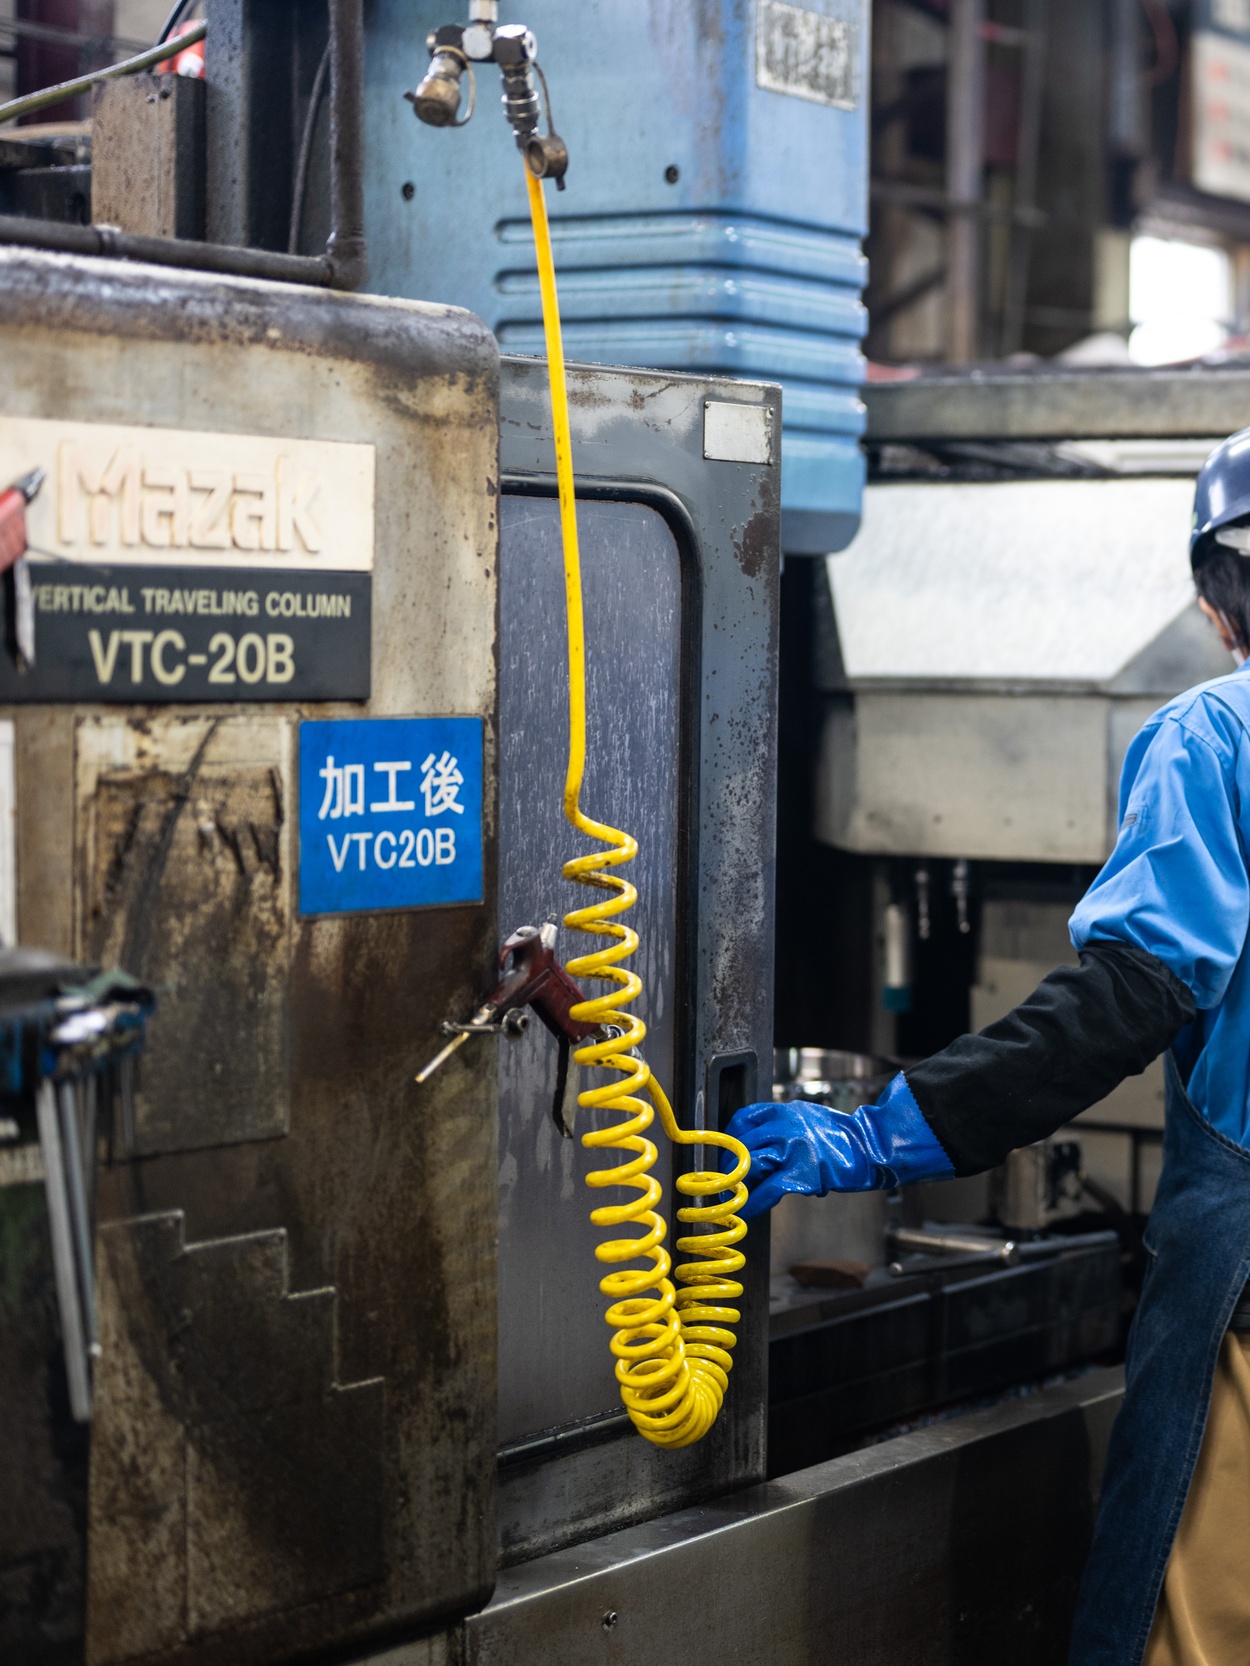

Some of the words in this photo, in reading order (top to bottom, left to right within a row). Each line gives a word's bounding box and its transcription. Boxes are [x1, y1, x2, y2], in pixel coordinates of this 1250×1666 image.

[56, 438, 321, 555] Mazak
[140, 588, 259, 616] TRAVELING
[265, 592, 351, 618] COLUMN
[88, 629, 296, 685] VTC-20B
[318, 750, 465, 821] 加工後
[326, 827, 457, 873] VTC20B
